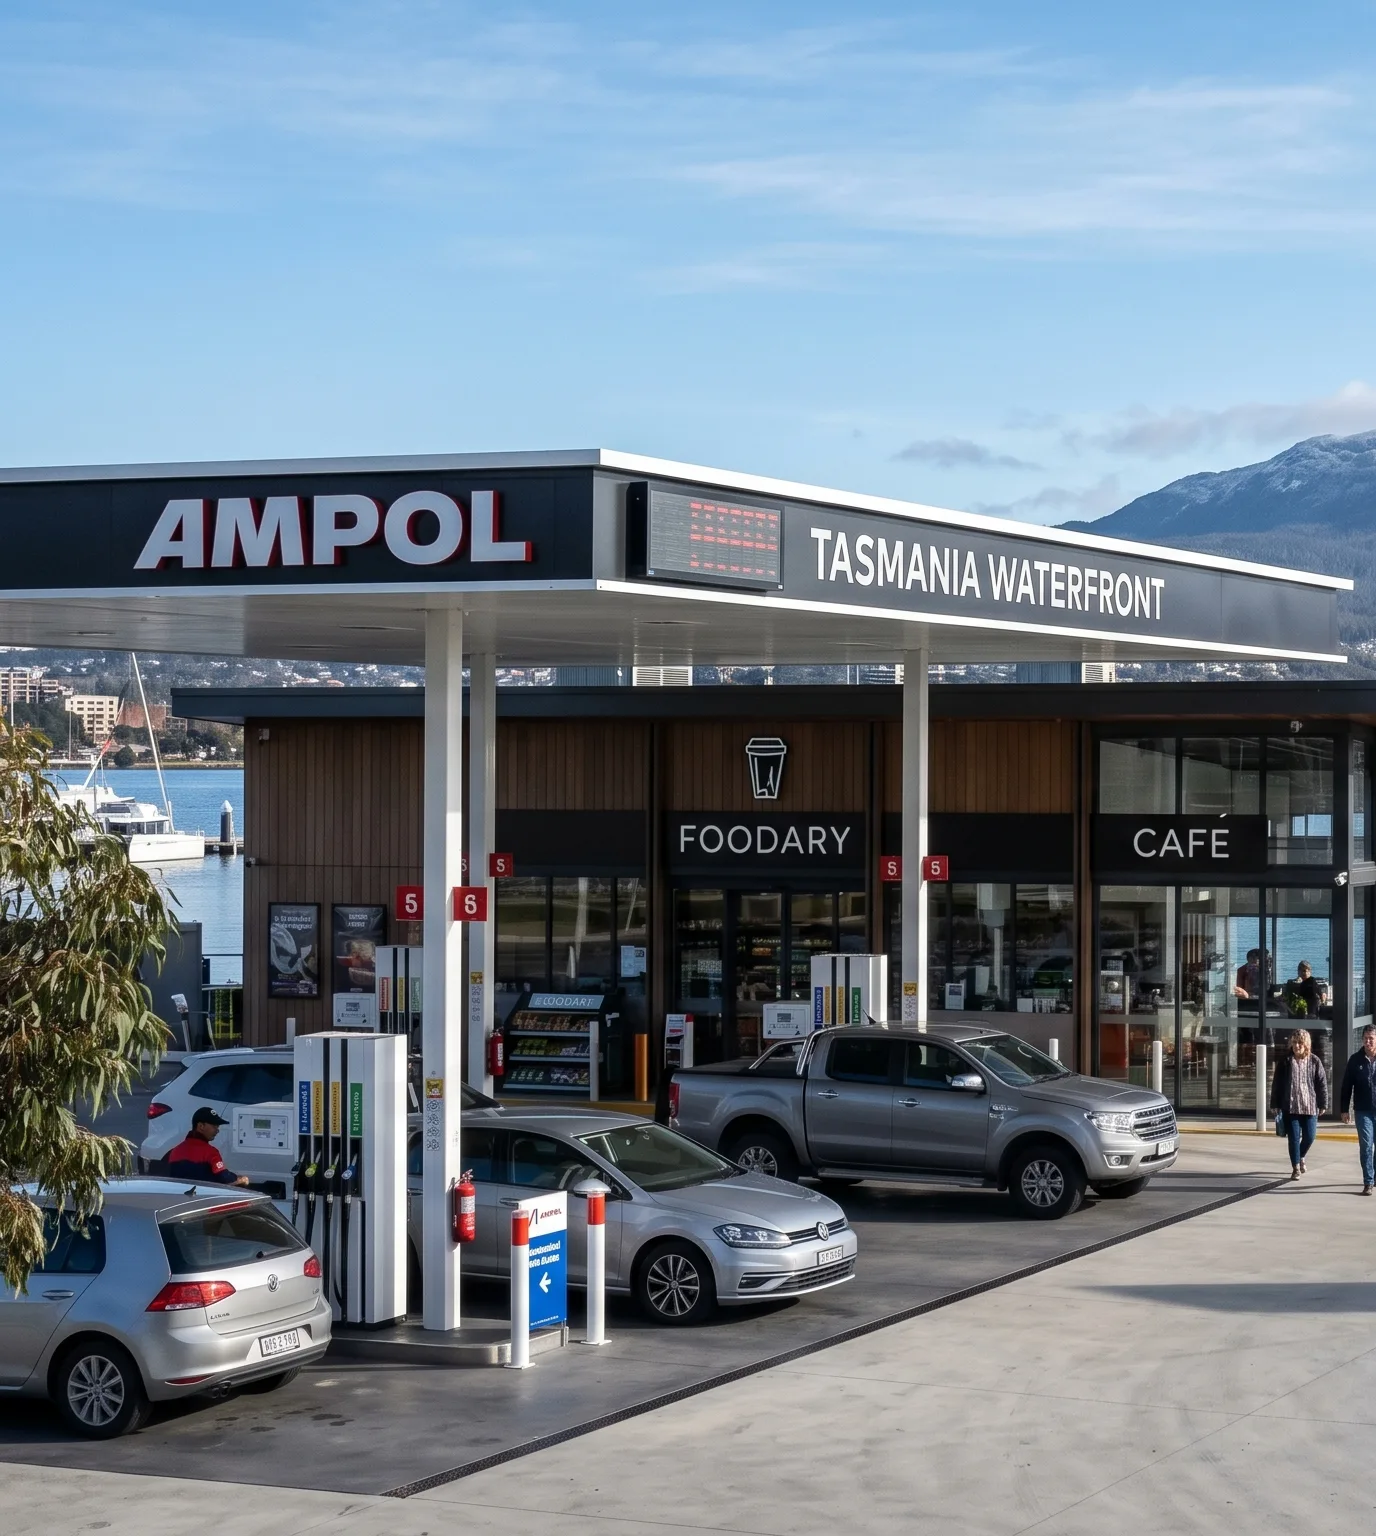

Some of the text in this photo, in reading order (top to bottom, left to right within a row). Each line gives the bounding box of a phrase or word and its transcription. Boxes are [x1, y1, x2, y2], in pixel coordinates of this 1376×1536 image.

[133, 490, 531, 570] AMPOL
[810, 527, 981, 599] TASMANIA
[988, 552, 1165, 620] WATERFRONT
[680, 825, 851, 855] FOODARY
[405, 893, 418, 914] 5
